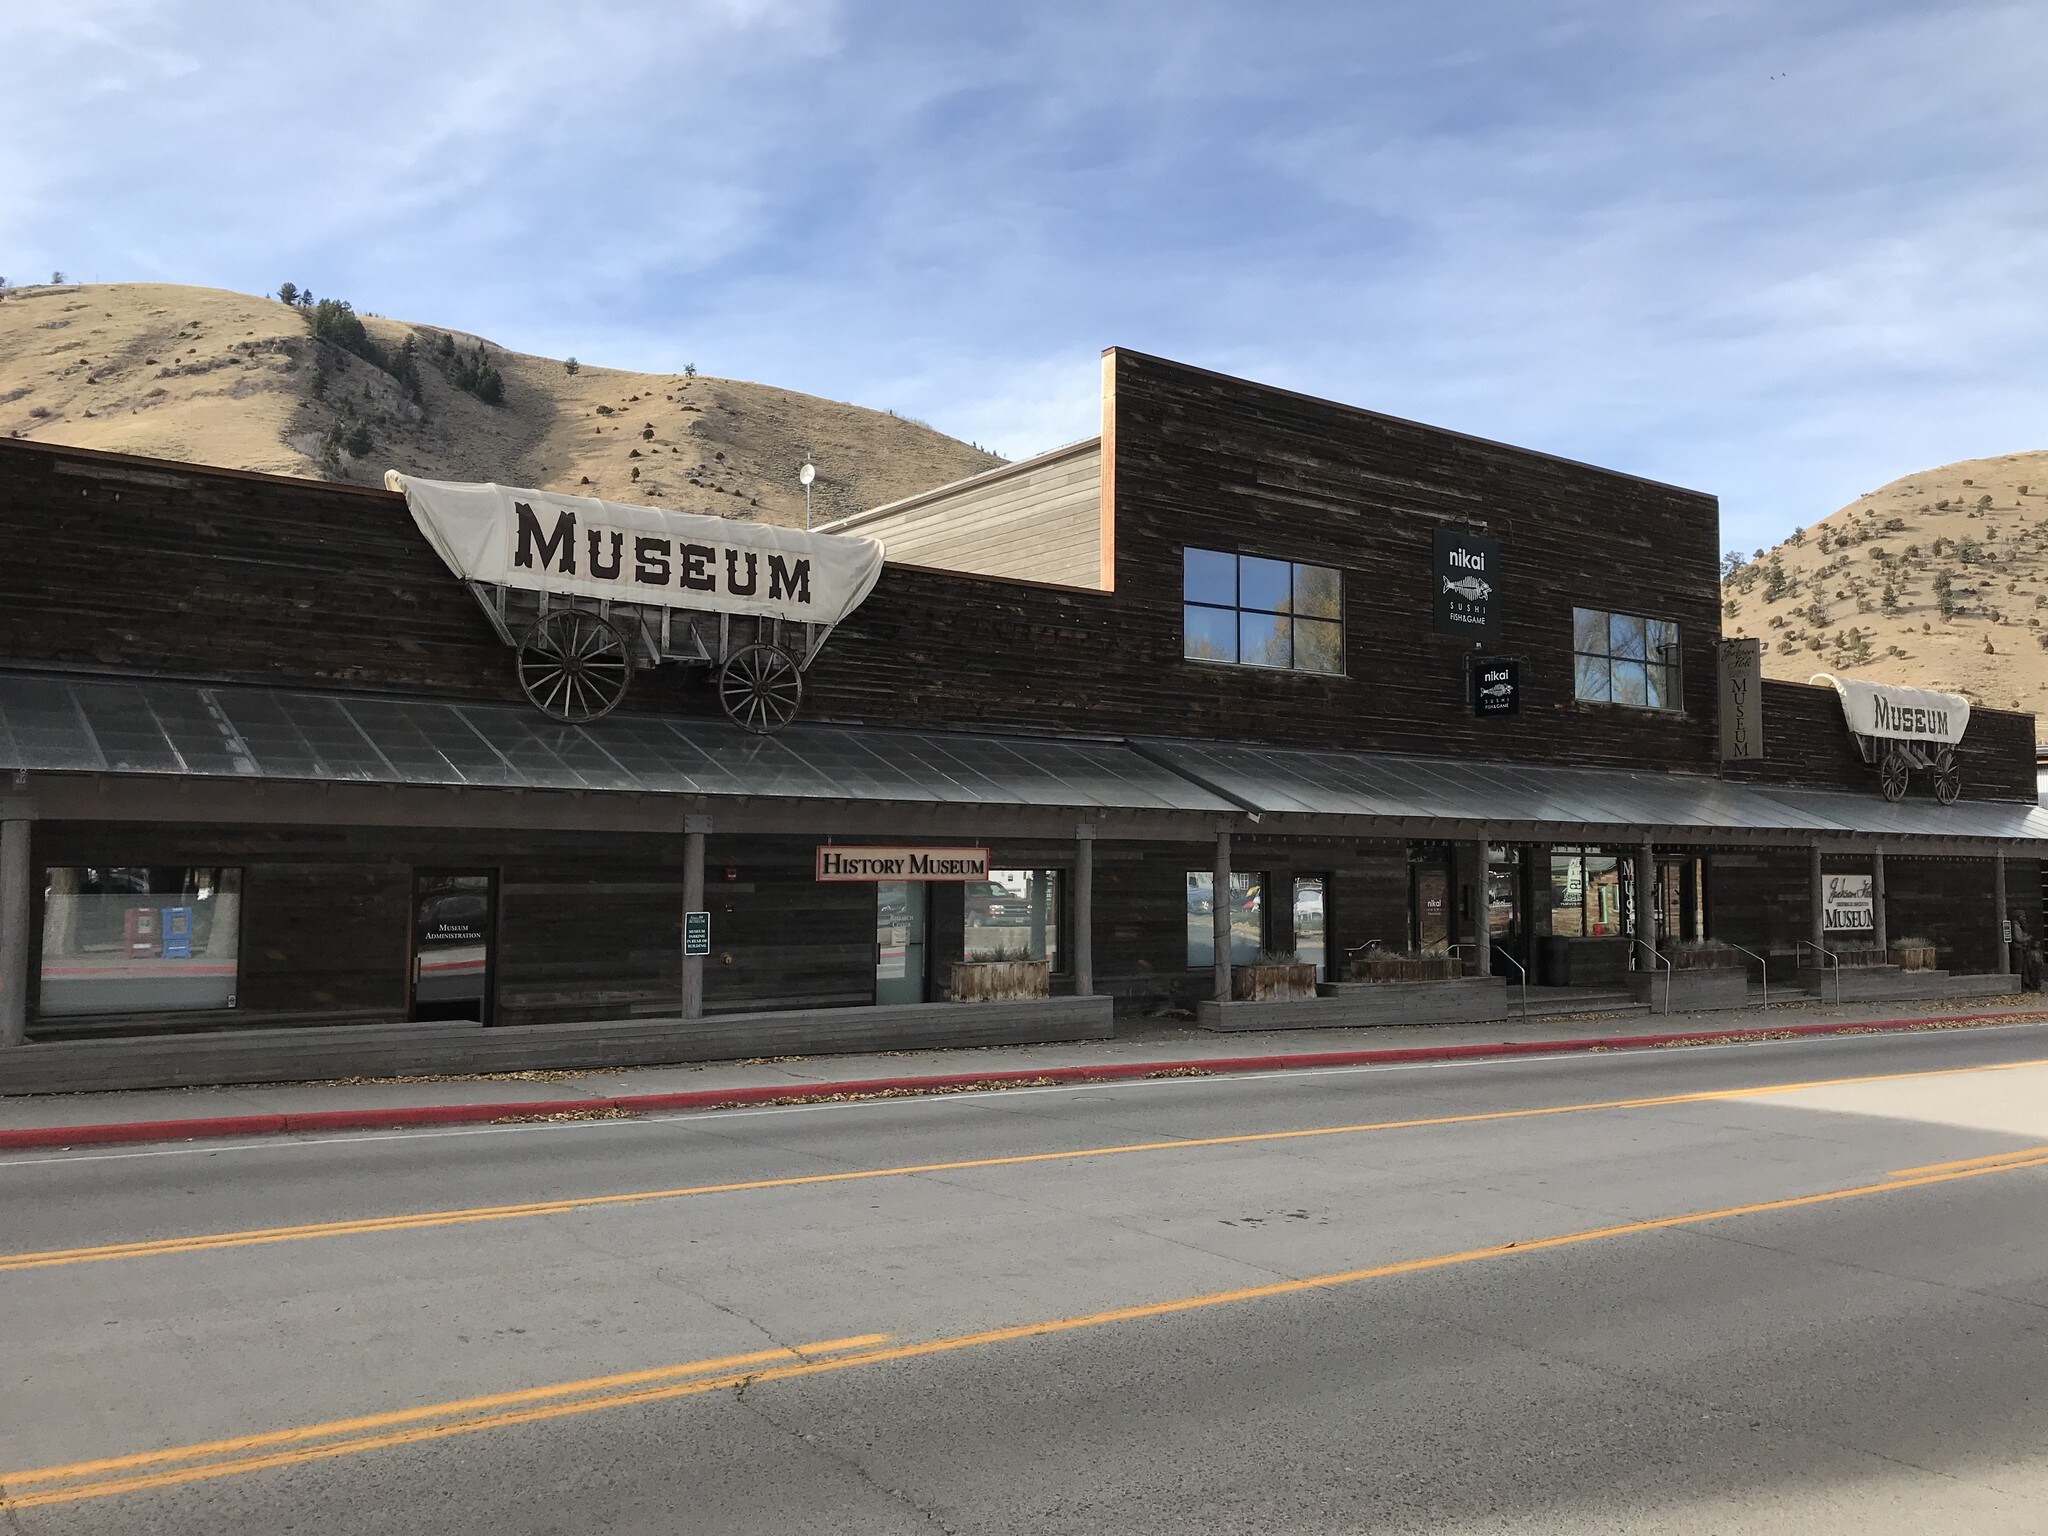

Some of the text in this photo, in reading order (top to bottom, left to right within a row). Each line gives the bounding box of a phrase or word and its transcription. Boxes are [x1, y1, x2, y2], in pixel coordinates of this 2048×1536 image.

[514, 501, 811, 604] MUSEUM
[1450, 548, 1485, 571] nikai
[1450, 602, 1486, 614] SUSHI
[1450, 613, 1486, 625] FISH&GAME
[1484, 669, 1509, 681] nikai
[1732, 678, 1749, 757] MUSEUM
[1873, 694, 1948, 735] MUSEUM
[823, 853, 984, 875] HISTORY MUSEUM
[1828, 877, 1857, 903] Jackson
[1427, 899, 1442, 907] nikai
[425, 932, 481, 940] ADMINISTRATION
[438, 923, 469, 932] MUSEUM
